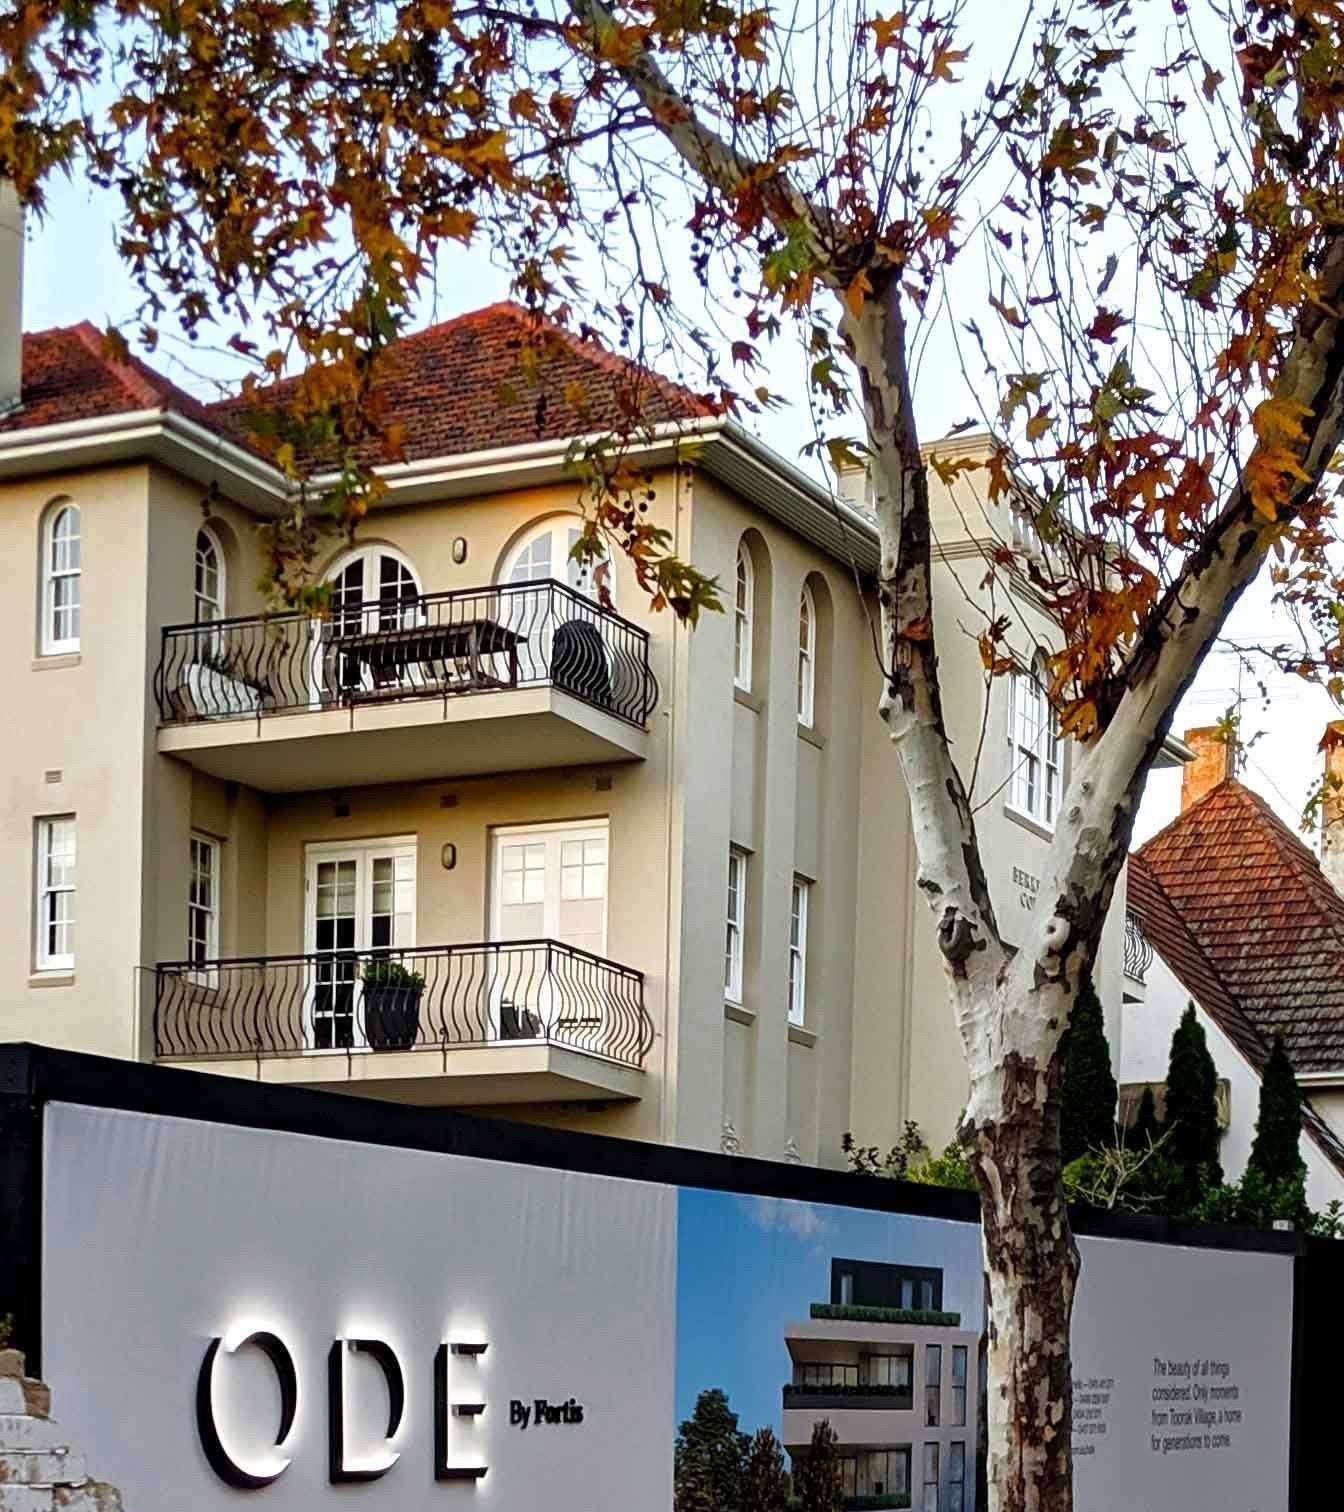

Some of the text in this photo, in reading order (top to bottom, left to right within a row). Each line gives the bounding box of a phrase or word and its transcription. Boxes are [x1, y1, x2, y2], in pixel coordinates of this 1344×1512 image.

[1153, 1358, 1230, 1379] The beauty of all things
[1152, 1384, 1239, 1404] considered. Only moments
[196, 1331, 489, 1490] ODE
[510, 1398, 584, 1430] By Fortis
[1152, 1408, 1169, 1425] from
[1170, 1408, 1192, 1424] Toorak
[1224, 1408, 1242, 1424] home
[1152, 1434, 1161, 1450] for
[1162, 1433, 1202, 1455] generations
[1204, 1434, 1211, 1449] to
